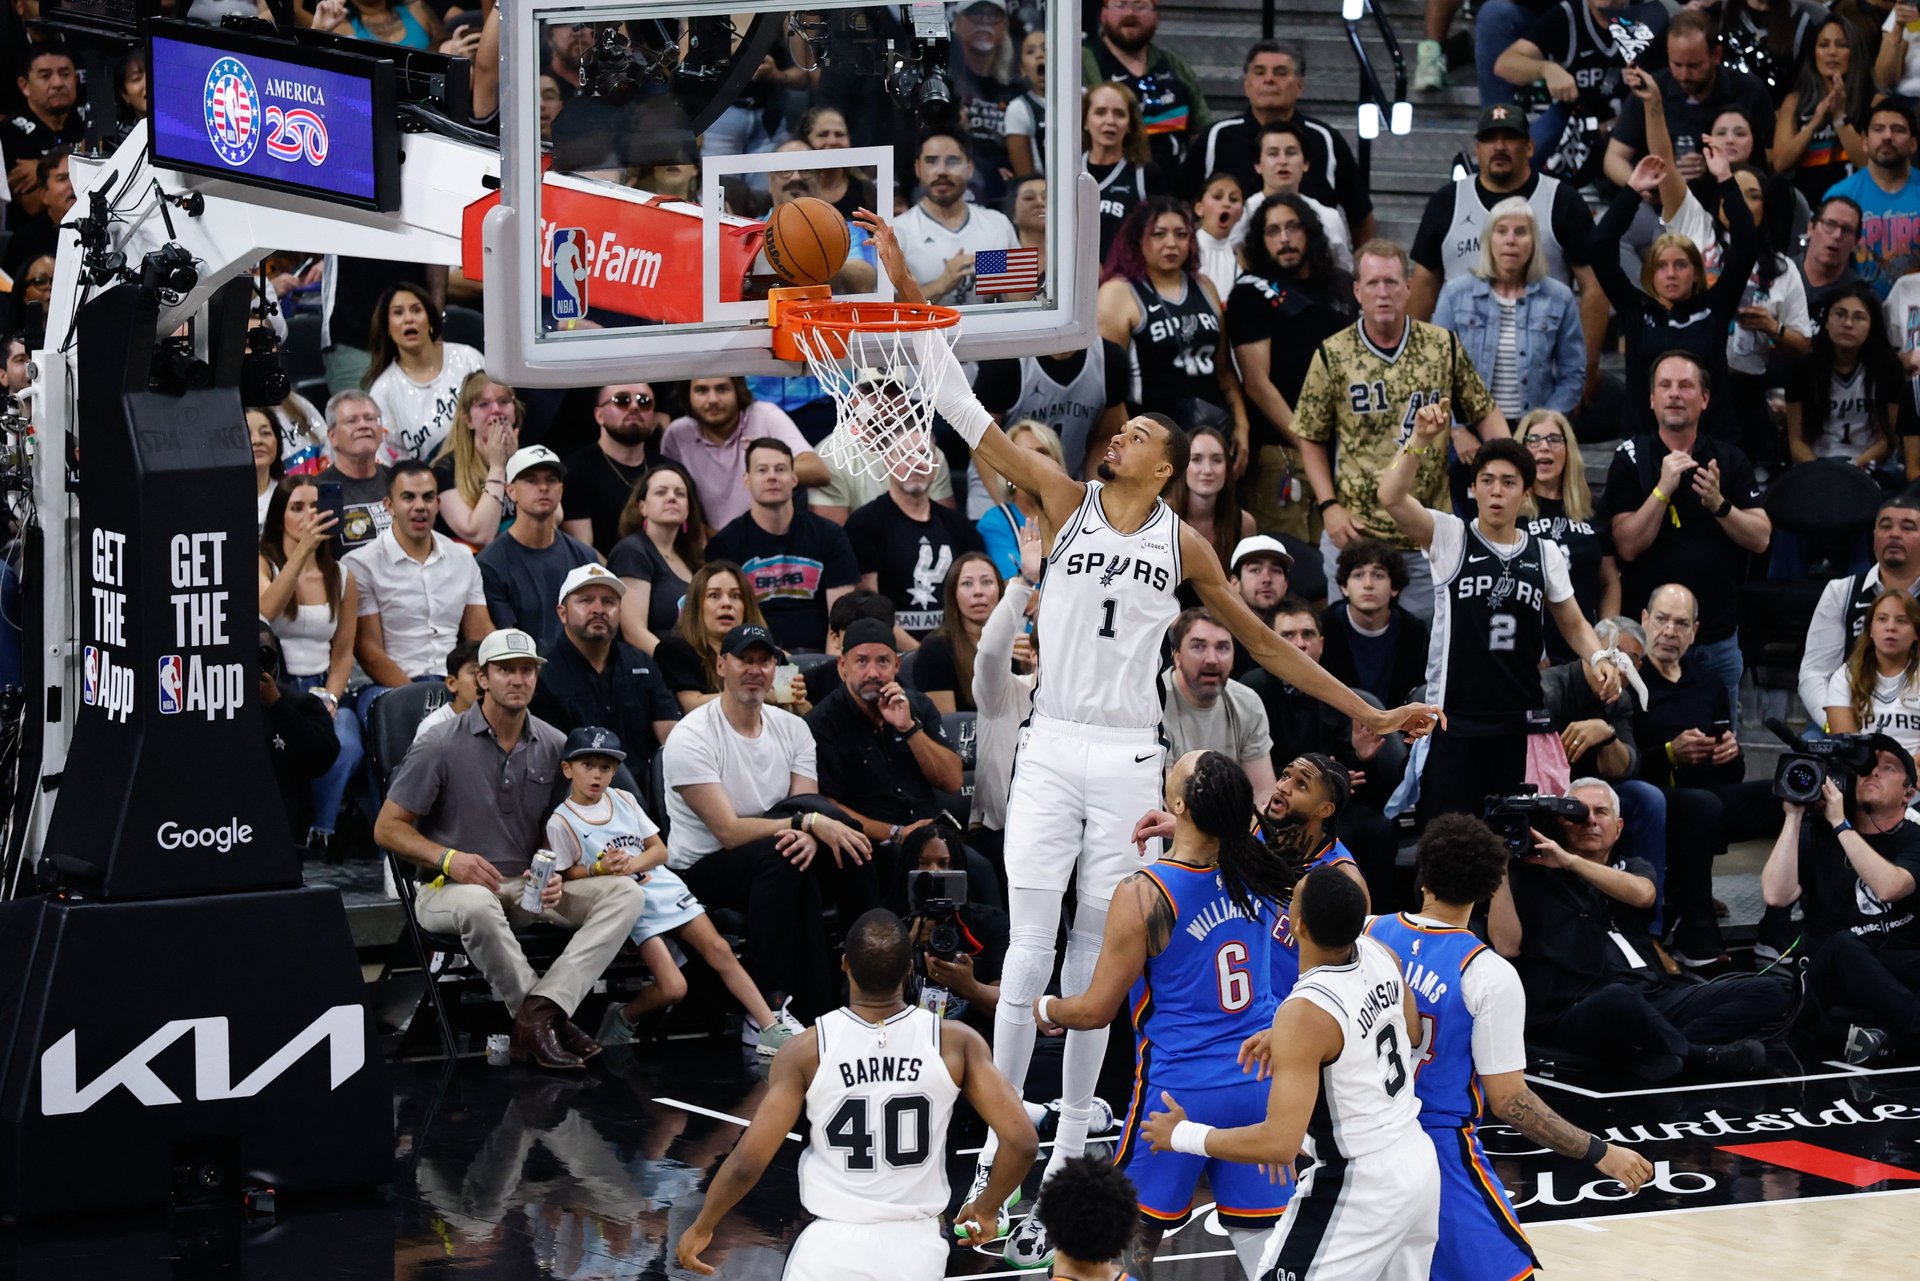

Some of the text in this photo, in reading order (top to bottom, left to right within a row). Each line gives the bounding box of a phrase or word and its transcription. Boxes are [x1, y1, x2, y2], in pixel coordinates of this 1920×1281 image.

[264, 77, 325, 106] AMERICA
[265, 105, 329, 167] 250
[593, 231, 662, 289] Farm
[1457, 237, 1480, 258] SAN
[557, 299, 574, 315] NBA
[1049, 401, 1094, 419] ANTON
[1349, 380, 1389, 414] 21
[92, 527, 126, 587] GET
[170, 531, 227, 588] GET
[1144, 540, 1166, 551] LEDGER
[1067, 552, 1169, 592] SPURS
[1458, 574, 1543, 611] SPURS
[91, 587, 127, 648] THE
[170, 591, 230, 648] THE
[1097, 597, 1118, 640] 1
[1488, 613, 1517, 651] 2
[97, 650, 135, 723] App
[186, 654, 244, 721] App
[1863, 713, 1920, 735] PURS
[157, 816, 253, 853] Google
[1215, 940, 1254, 1014] 6
[1404, 961, 1447, 1004] IAMS
[1356, 979, 1400, 1039] JOHNSON
[41, 1003, 366, 1117] KIA
[838, 1056, 923, 1088] BARNES
[1376, 1021, 1407, 1099] 3
[822, 1091, 934, 1173] 40
[1478, 1099, 1920, 1156] Curtside
